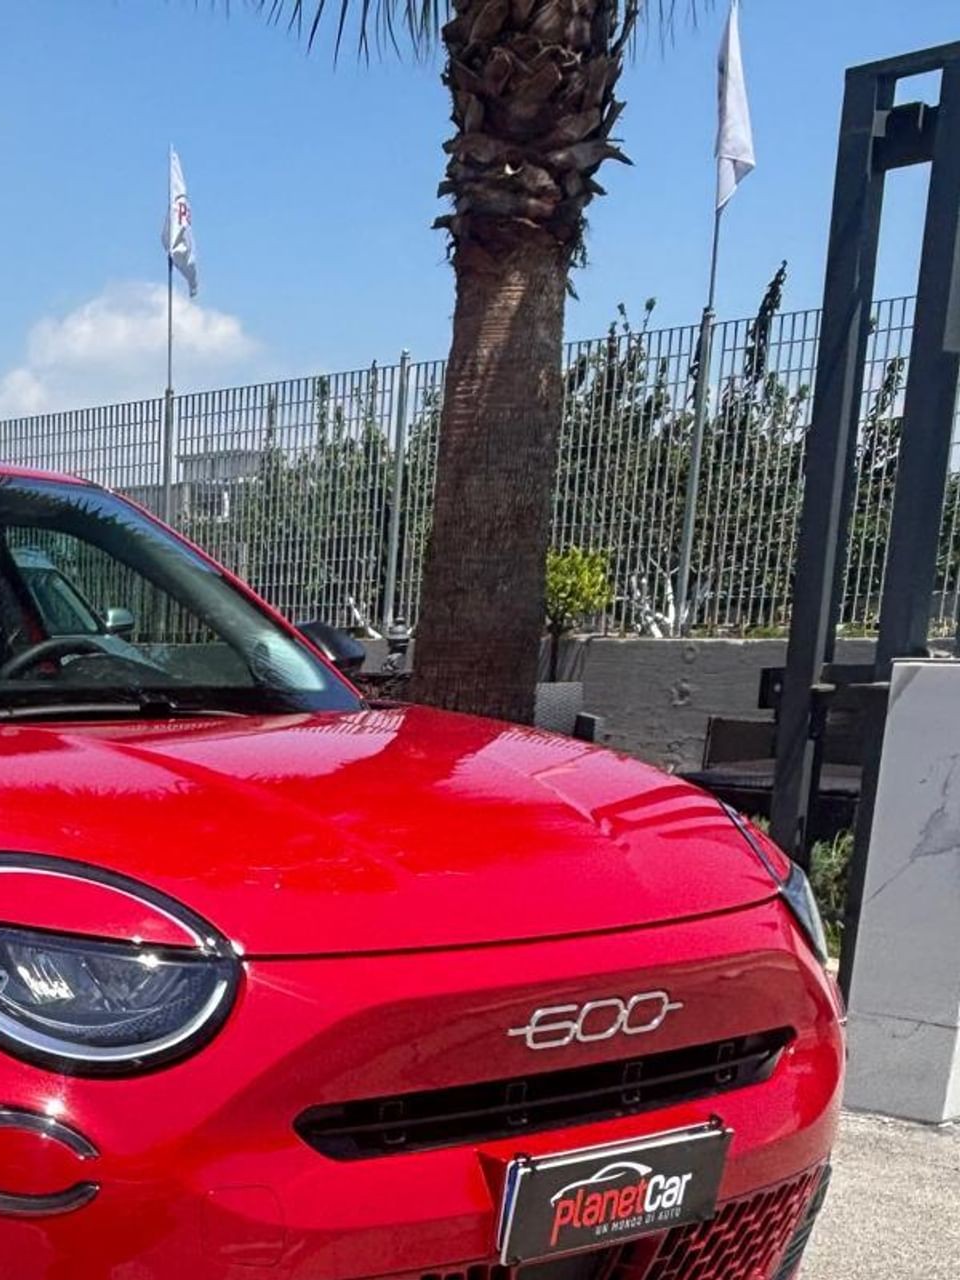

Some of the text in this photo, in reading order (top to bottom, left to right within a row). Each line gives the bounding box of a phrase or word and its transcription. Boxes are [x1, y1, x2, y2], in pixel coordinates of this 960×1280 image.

[507, 991, 683, 1050] 600
[611, 1216, 642, 1232] MONDO
[658, 1207, 682, 1221] AUTO
